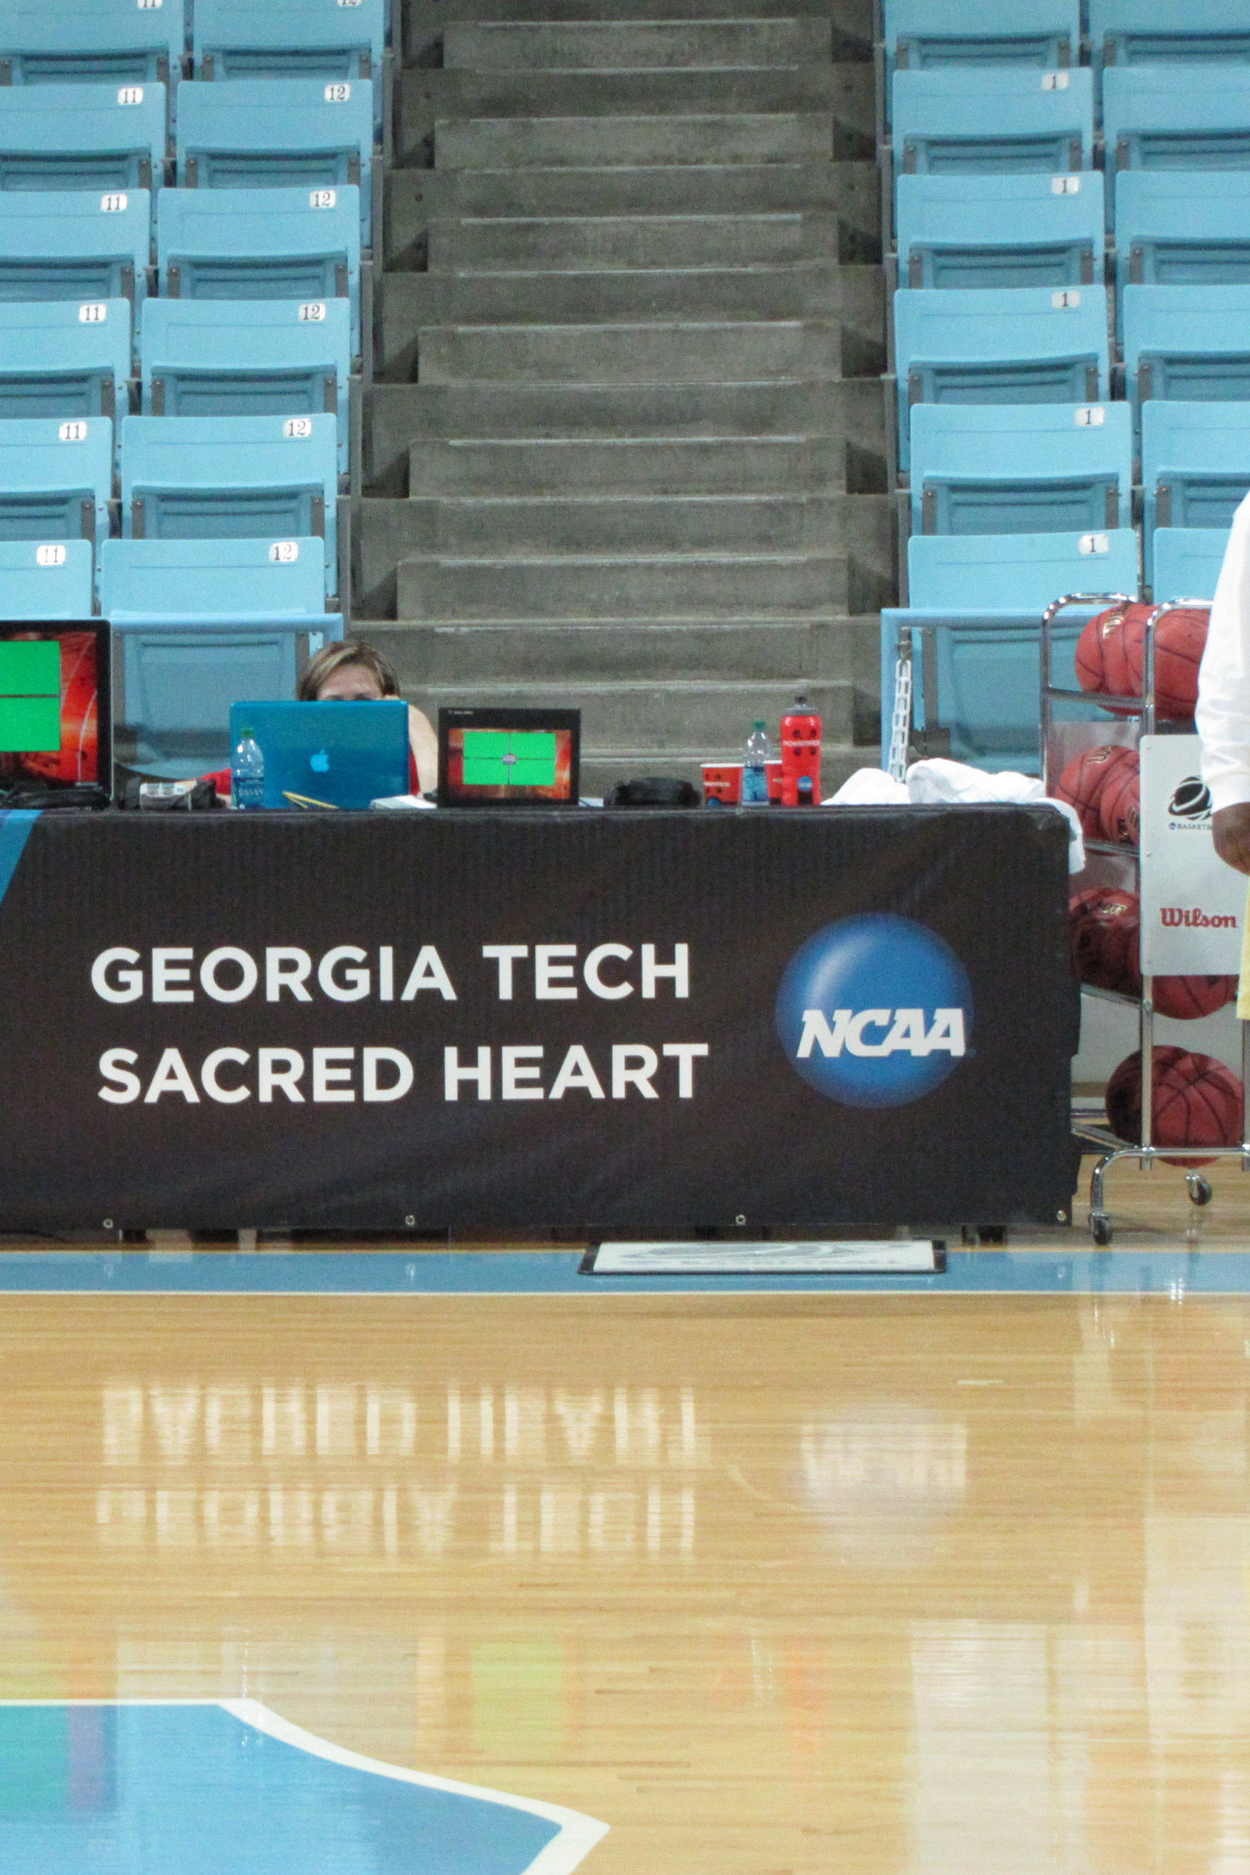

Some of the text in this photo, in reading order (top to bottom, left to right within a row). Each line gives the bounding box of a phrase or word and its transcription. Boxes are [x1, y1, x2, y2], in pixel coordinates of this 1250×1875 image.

[122, 88, 137, 104] 11
[329, 84, 346, 101] 12
[106, 196, 120, 211] 11
[313, 191, 331, 207] 12
[85, 306, 100, 322] 11
[302, 304, 321, 320] 12
[65, 424, 80, 440] 11
[288, 421, 306, 437] 12
[44, 546, 60, 564] 11
[273, 543, 294, 562] 12
[1160, 908, 1237, 928] Wilson
[90, 943, 690, 1004] GEORGIA TECH
[796, 1008, 966, 1058] NCAA
[97, 1043, 709, 1104] SACRED HEART
